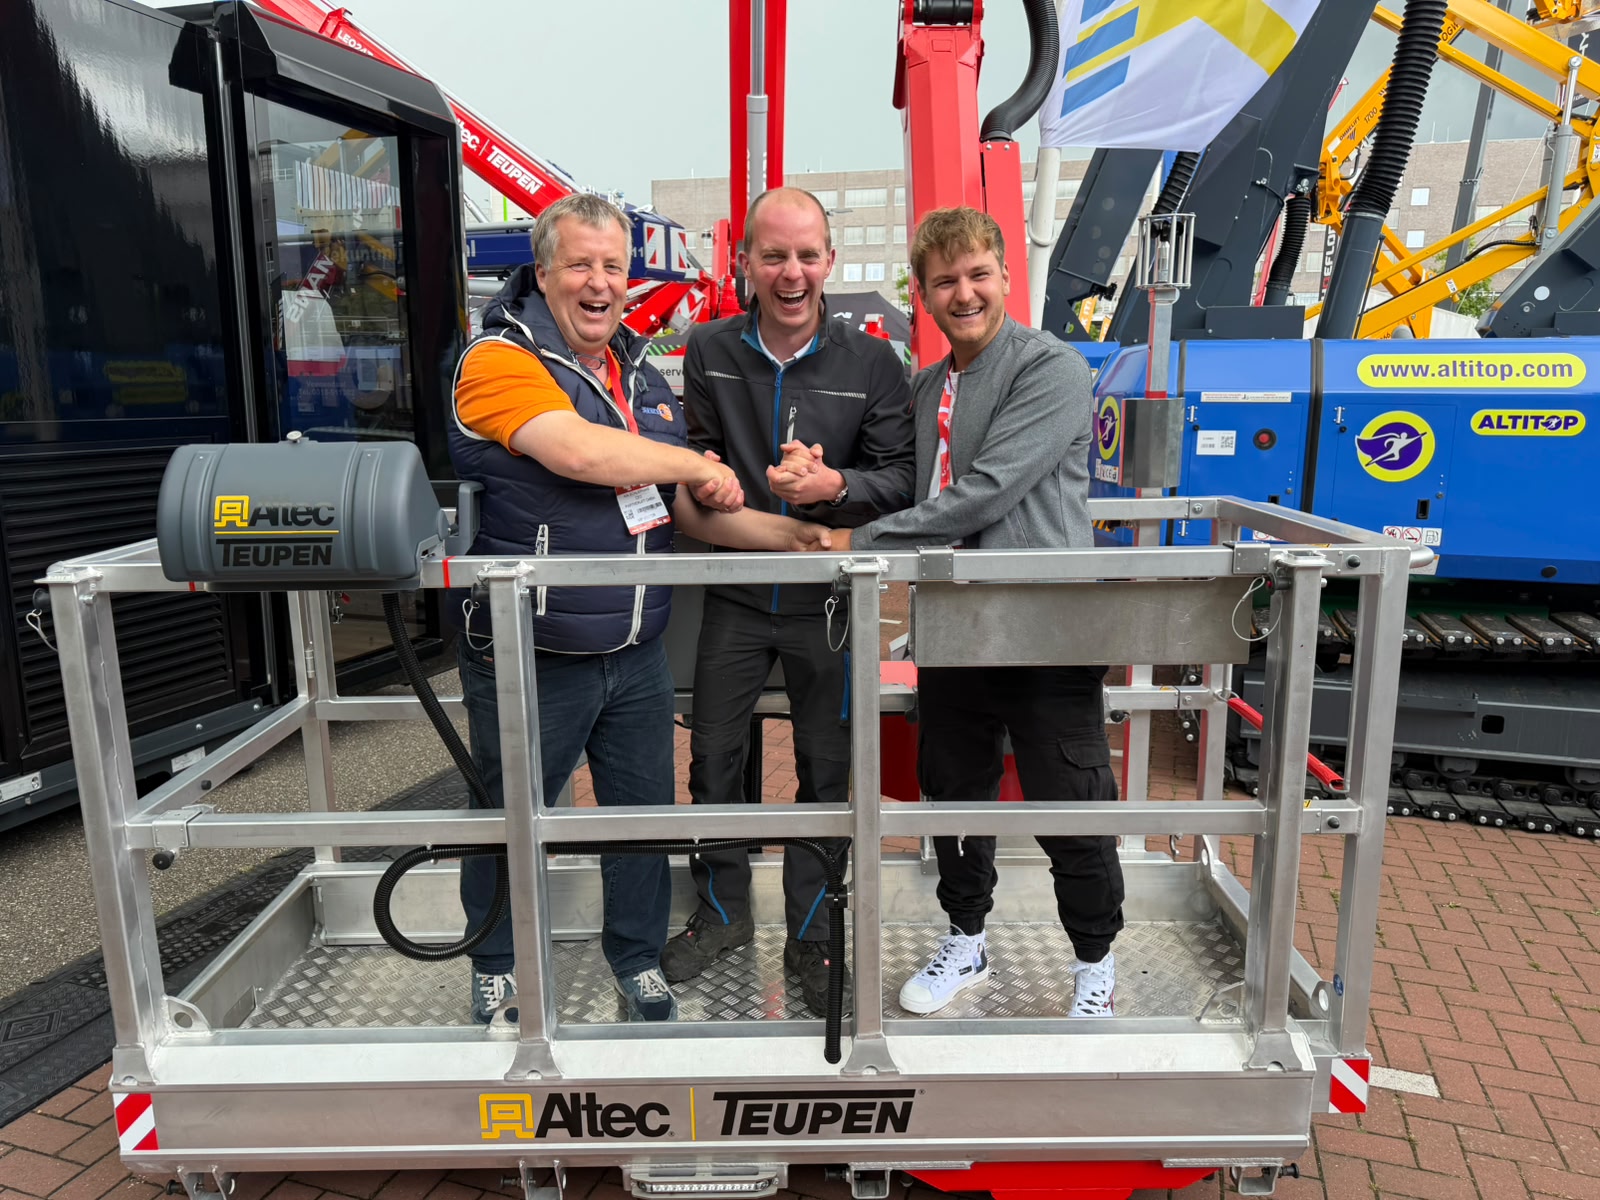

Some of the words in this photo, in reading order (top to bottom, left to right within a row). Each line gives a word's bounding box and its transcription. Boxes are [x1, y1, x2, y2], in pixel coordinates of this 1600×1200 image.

[1364, 106, 1378, 124] 1700
[486, 145, 544, 196] TEUPEN
[659, 368, 684, 376] serv
[1370, 360, 1573, 381] www.altitop.com
[1478, 415, 1579, 431] ALTITOP
[248, 502, 335, 526] Altec
[215, 537, 333, 567] TEUPEN
[535, 1091, 671, 1138] Altec
[713, 1088, 917, 1136] TEUPEN
